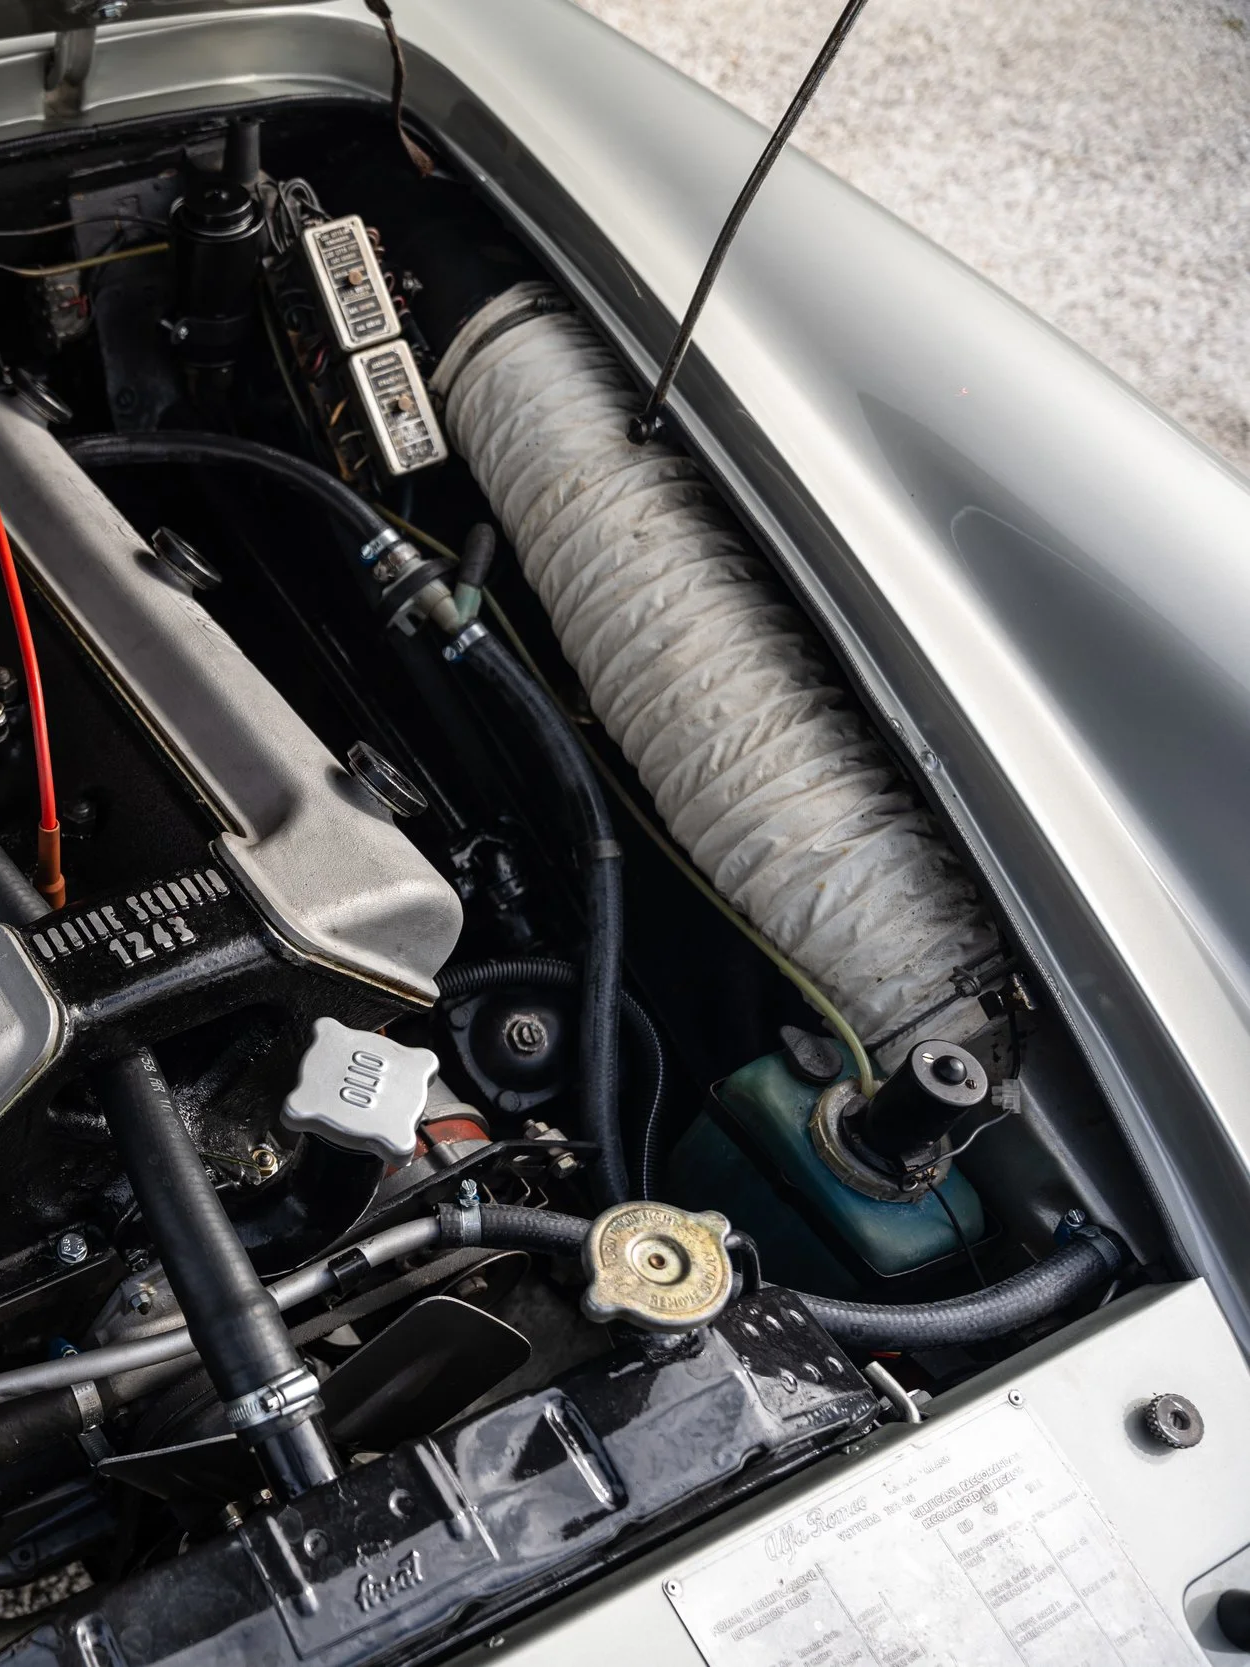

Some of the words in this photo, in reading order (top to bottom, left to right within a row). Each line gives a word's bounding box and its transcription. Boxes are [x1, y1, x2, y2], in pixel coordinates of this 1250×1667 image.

[109, 915, 196, 968] 1243
[148, 1077, 166, 1093] AR
[339, 1049, 386, 1110] OLIO
[640, 1209, 681, 1227] TIGHT
[648, 1291, 702, 1309] REMOVE
[921, 1490, 982, 1530] RECOMMENDED
[764, 1521, 810, 1565] Alfa
[806, 1496, 867, 1538] Romeo
